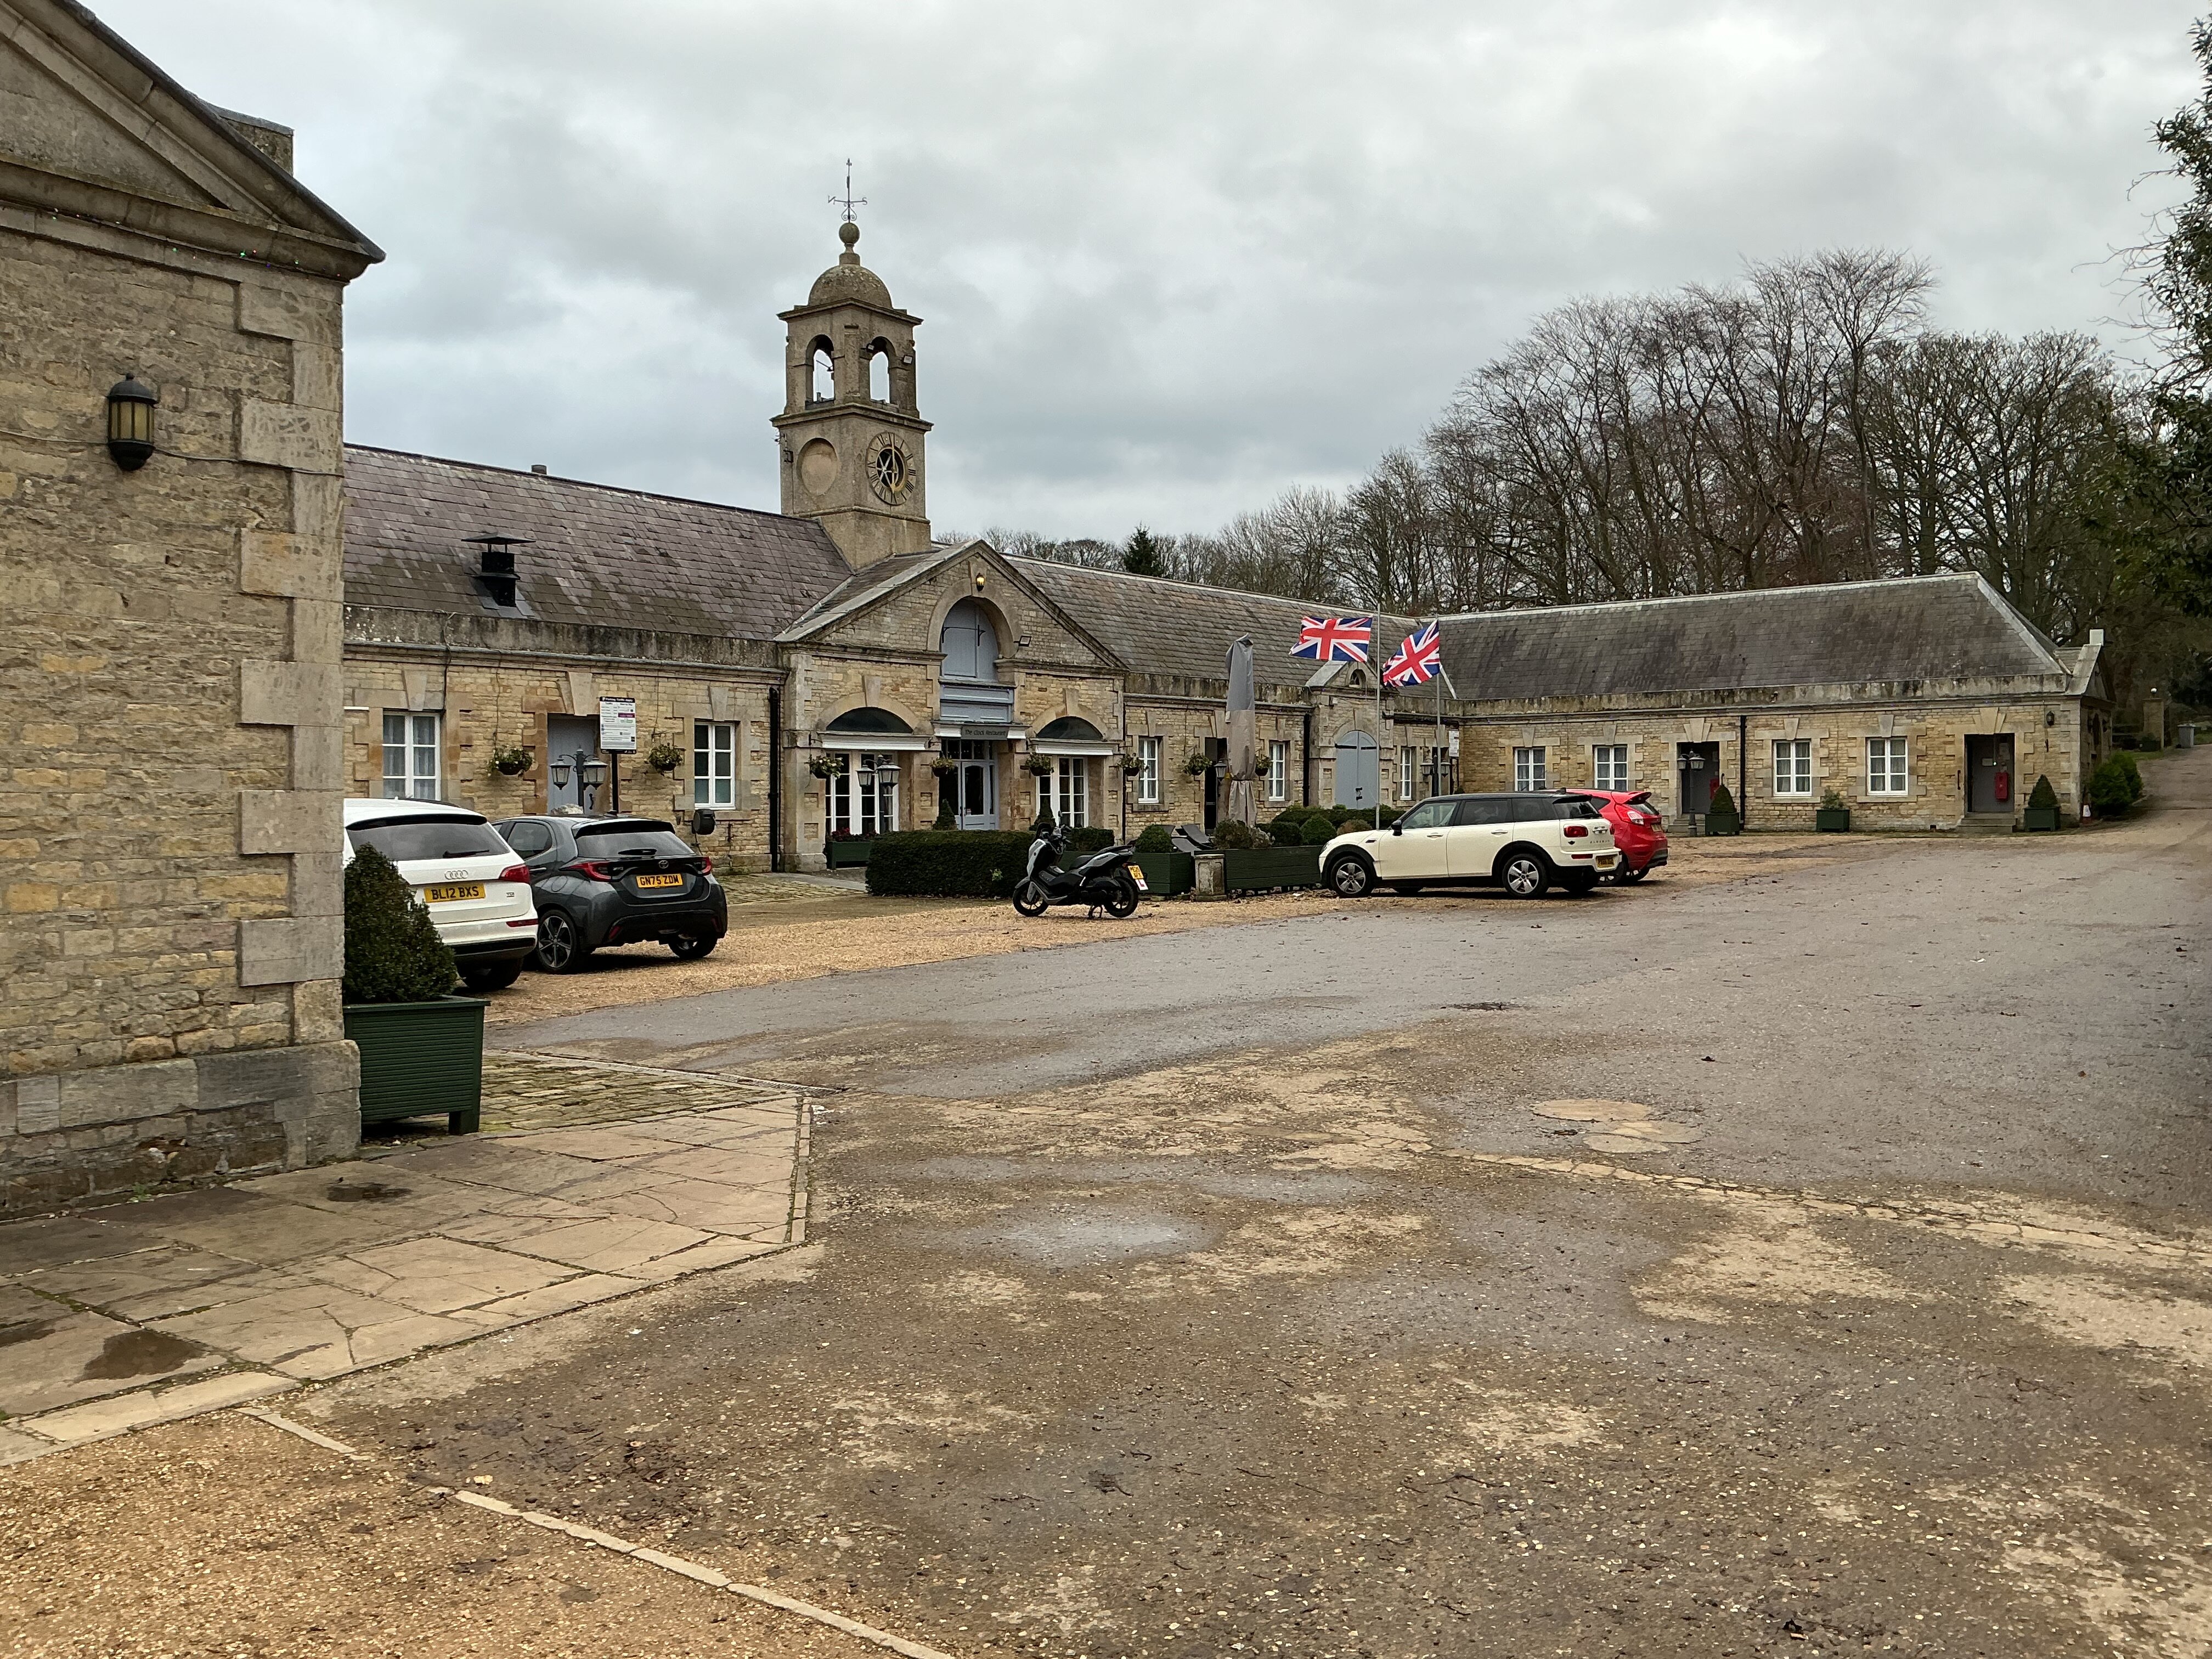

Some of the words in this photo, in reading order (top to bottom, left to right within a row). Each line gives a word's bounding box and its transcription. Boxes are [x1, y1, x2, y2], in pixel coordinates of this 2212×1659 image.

[908, 468, 917, 477] III
[639, 876, 662, 886] GN75
[431, 887, 456, 900] BL12
[458, 886, 479, 898] BXS
